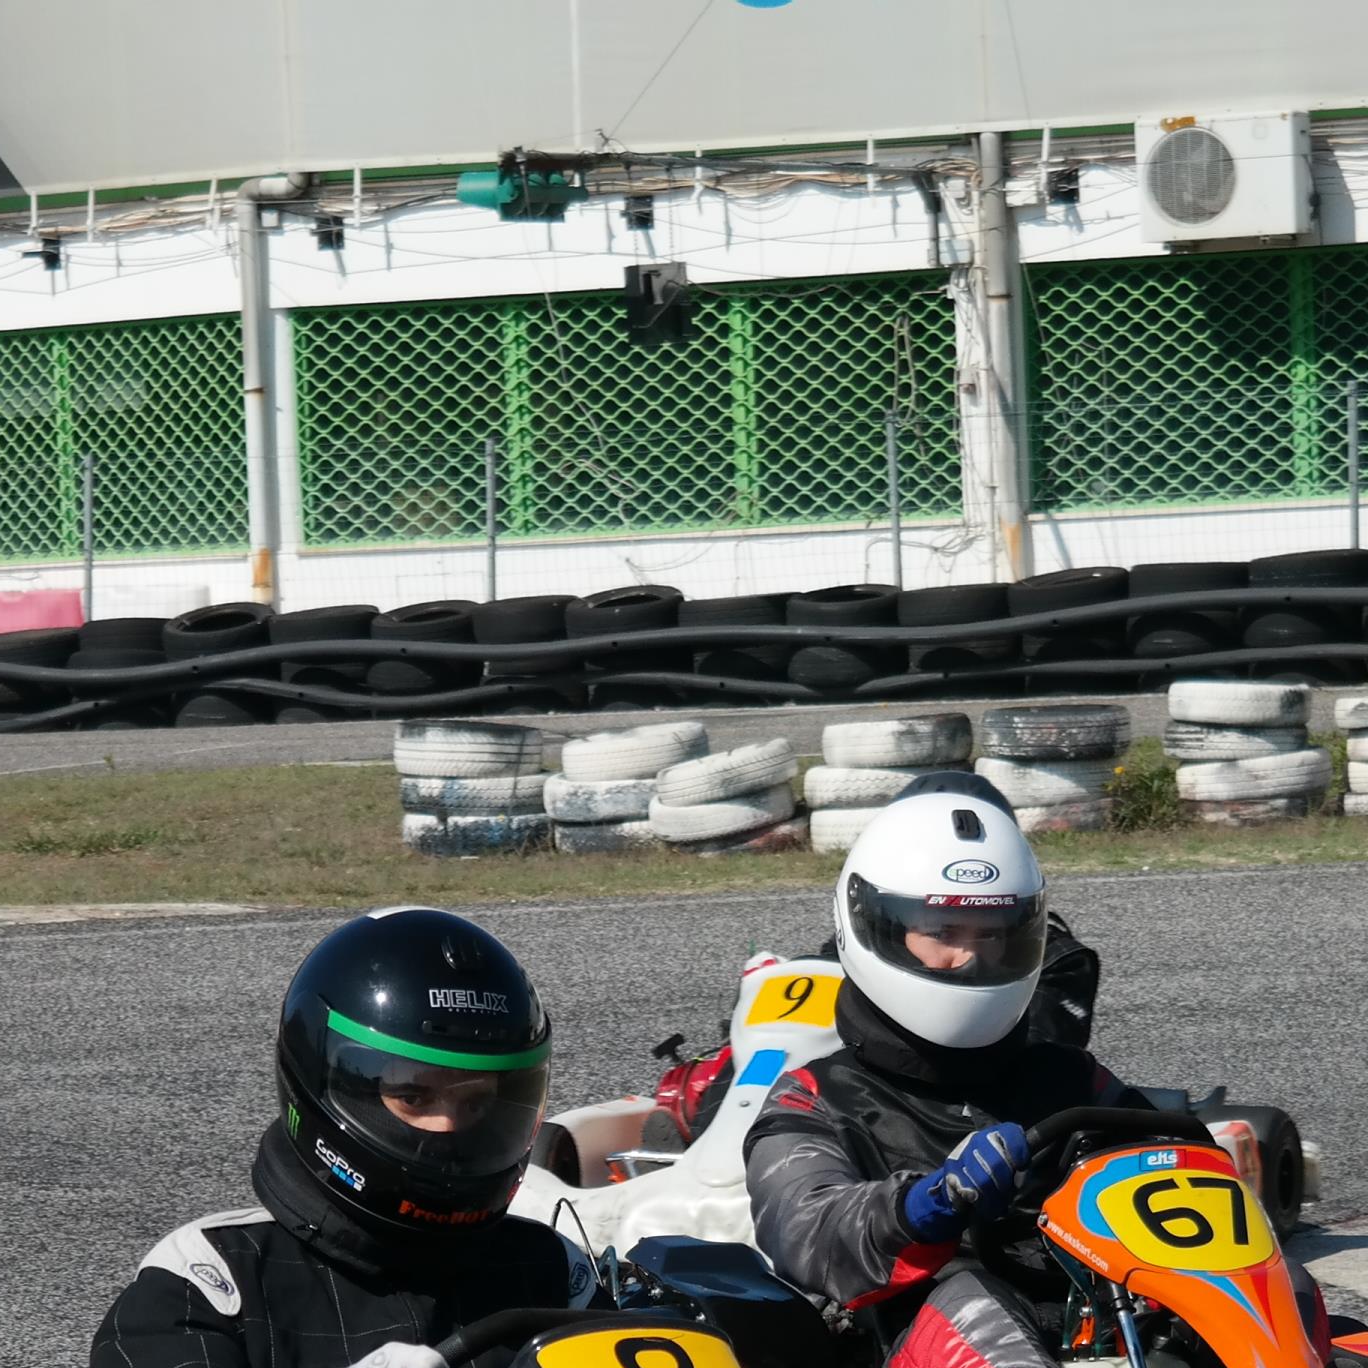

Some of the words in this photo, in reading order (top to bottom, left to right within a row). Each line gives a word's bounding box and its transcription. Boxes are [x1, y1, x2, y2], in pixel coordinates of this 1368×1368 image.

[429, 989, 508, 1013] HELIX
[776, 976, 814, 1020] 9
[1133, 1177, 1249, 1248] 67
